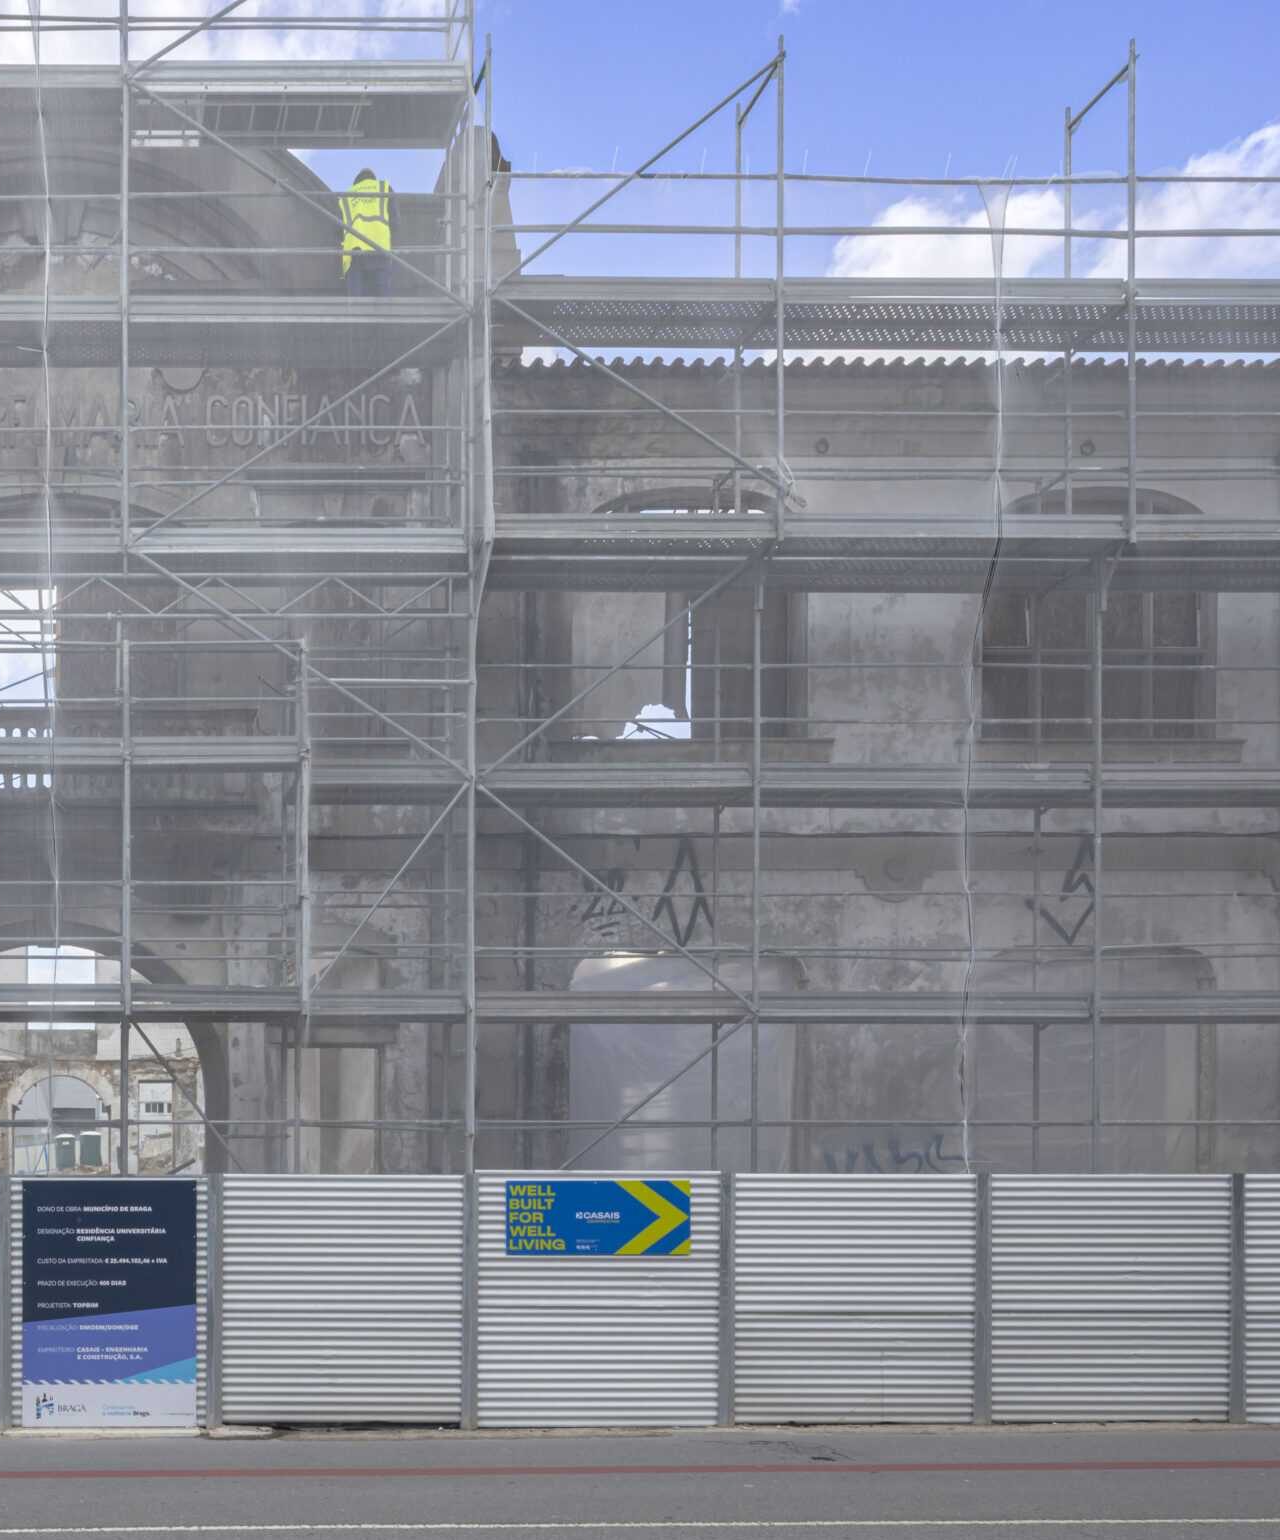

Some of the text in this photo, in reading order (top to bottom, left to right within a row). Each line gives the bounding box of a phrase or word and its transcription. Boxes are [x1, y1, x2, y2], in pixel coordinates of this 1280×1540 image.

[509, 1184, 556, 1196] WELL
[83, 1204, 118, 1212] MUNICÍPIO
[509, 1198, 555, 1210] BUILT
[509, 1212, 544, 1223] FOR
[583, 1211, 620, 1219] CASAIS
[509, 1225, 556, 1237] WELL
[509, 1239, 566, 1251] LIVING
[57, 1404, 87, 1412] BRAGA
